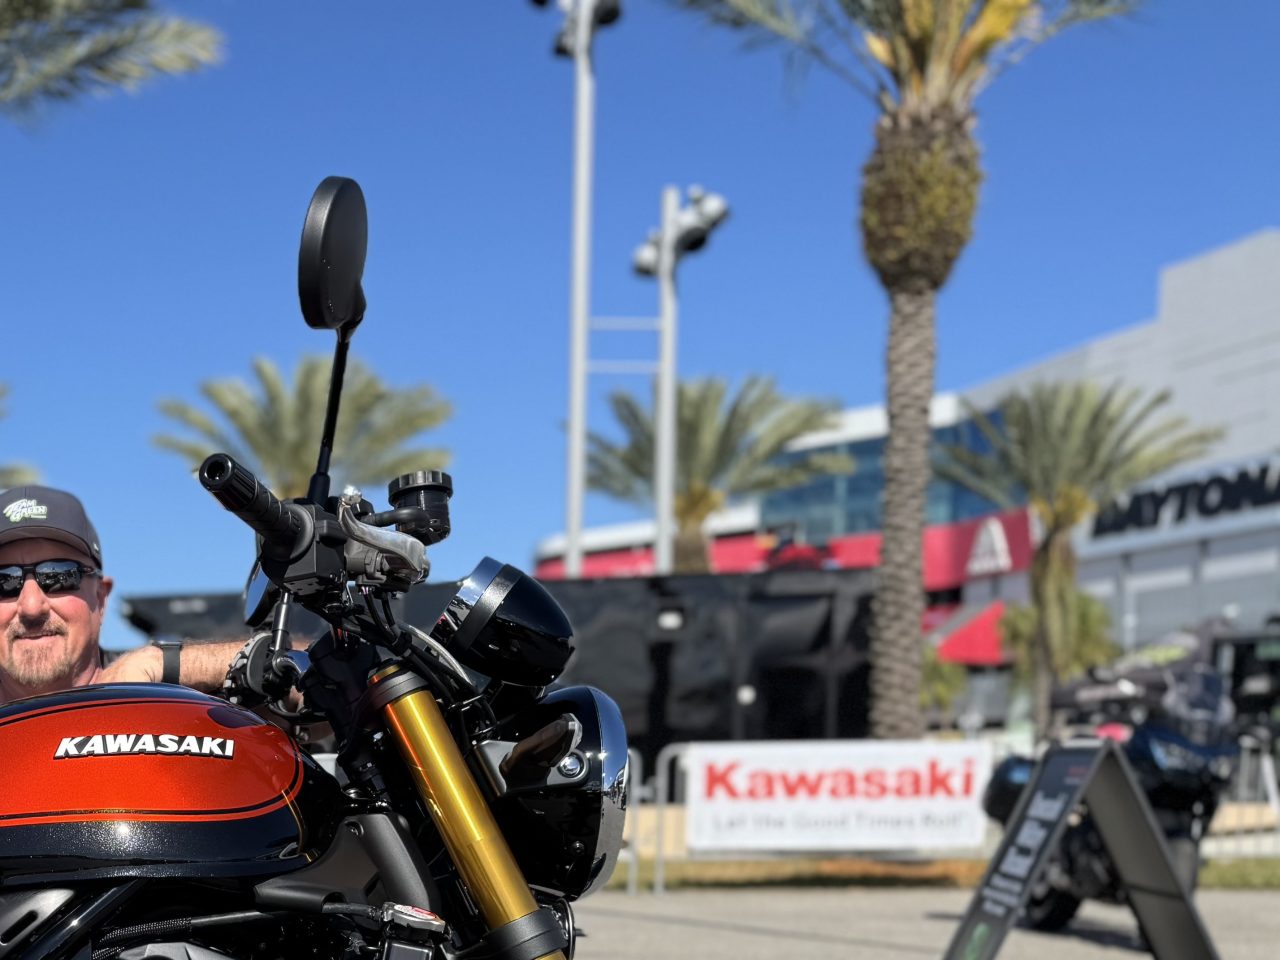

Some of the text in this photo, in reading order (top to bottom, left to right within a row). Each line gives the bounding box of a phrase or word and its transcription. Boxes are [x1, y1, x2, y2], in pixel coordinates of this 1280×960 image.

[3, 499, 37, 517] TEAM
[54, 734, 235, 758] KAWASAKI
[704, 758, 975, 800] Kawasaki
[853, 811, 914, 828] Times
